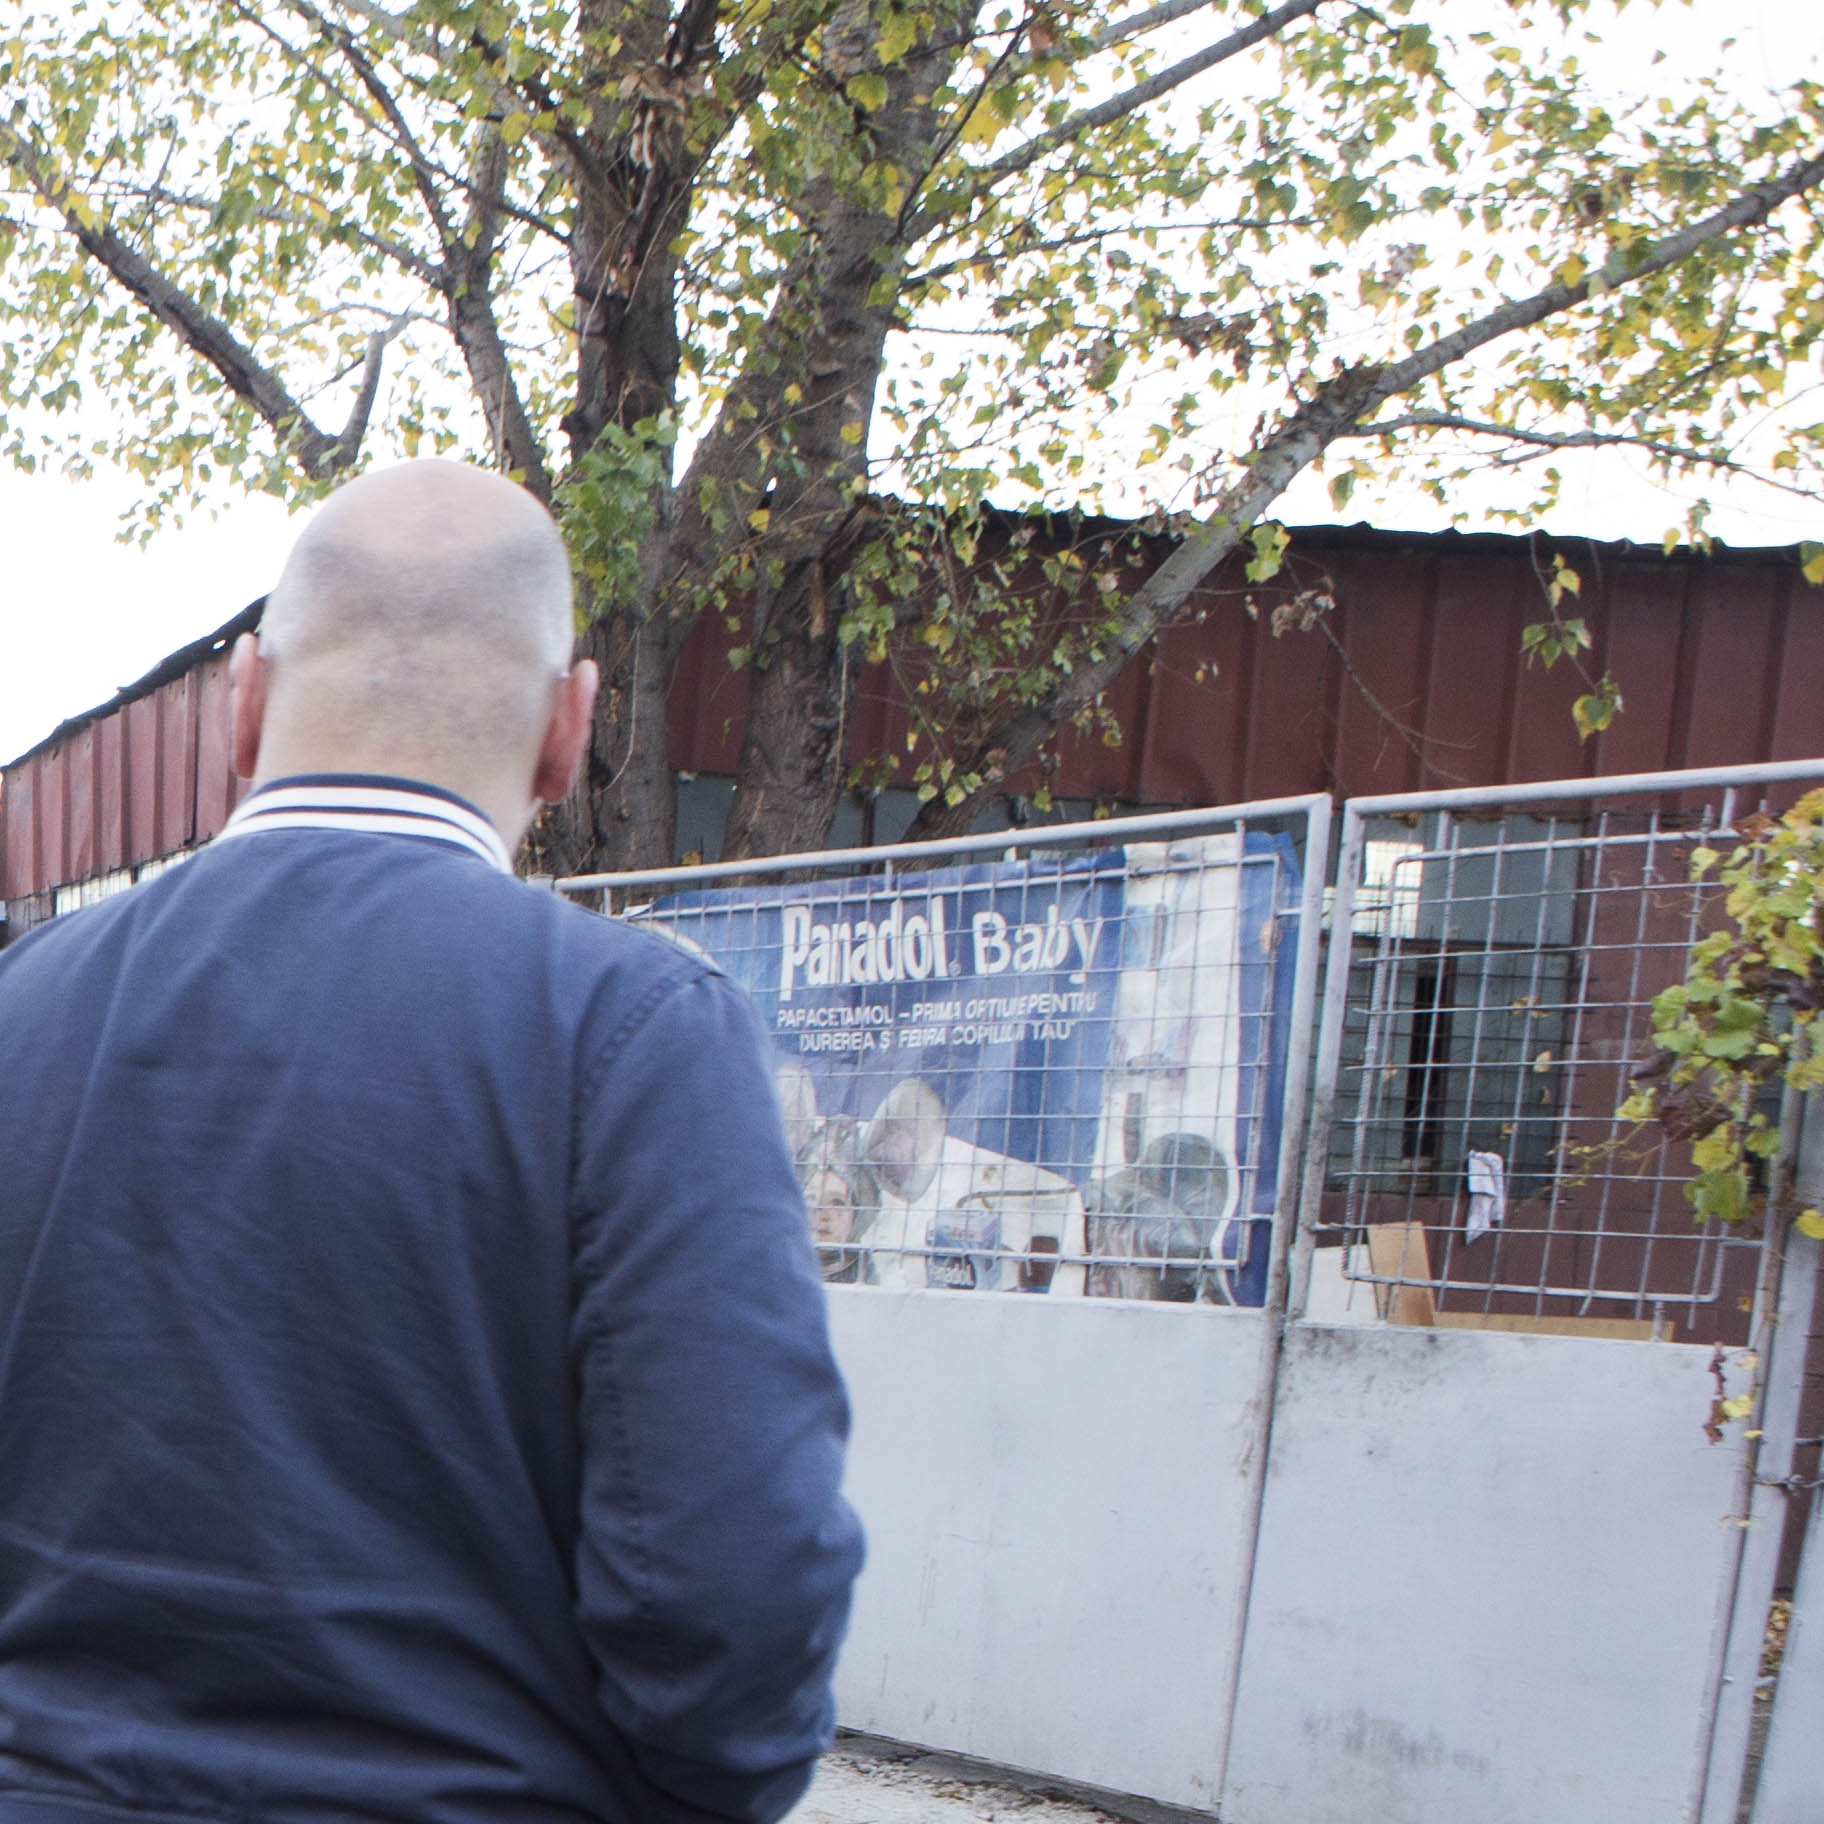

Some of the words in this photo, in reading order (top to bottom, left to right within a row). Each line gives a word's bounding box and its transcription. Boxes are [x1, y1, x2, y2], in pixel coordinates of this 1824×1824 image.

[779, 896, 949, 1001] Panadol
[972, 903, 1103, 985] Baby
[776, 1004, 894, 1028] PARACETAMOL
[912, 1001, 962, 1023] PRIMA
[800, 1030, 875, 1051] DUREREA
